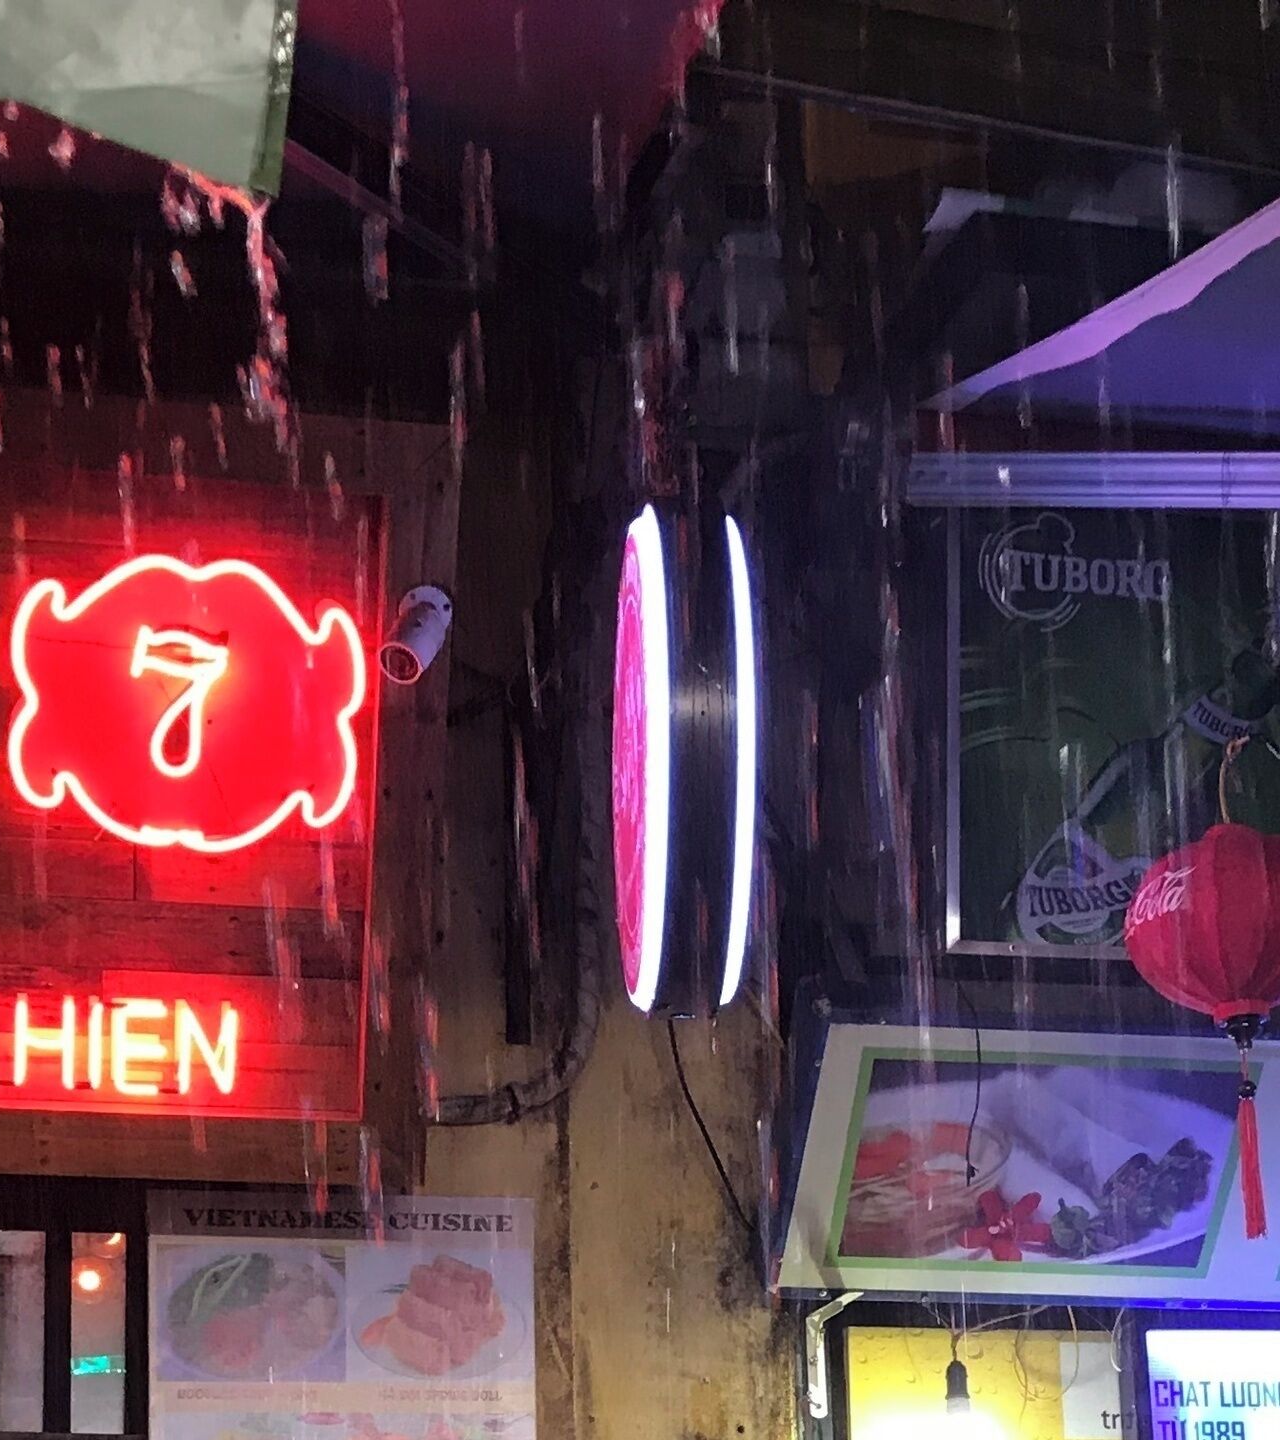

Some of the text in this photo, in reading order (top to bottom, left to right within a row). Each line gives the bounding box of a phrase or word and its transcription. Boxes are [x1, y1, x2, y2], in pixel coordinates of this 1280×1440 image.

[130, 624, 228, 778] 7
[14, 995, 239, 1095] HIEN
[390, 1211, 513, 1233] CUISINE
